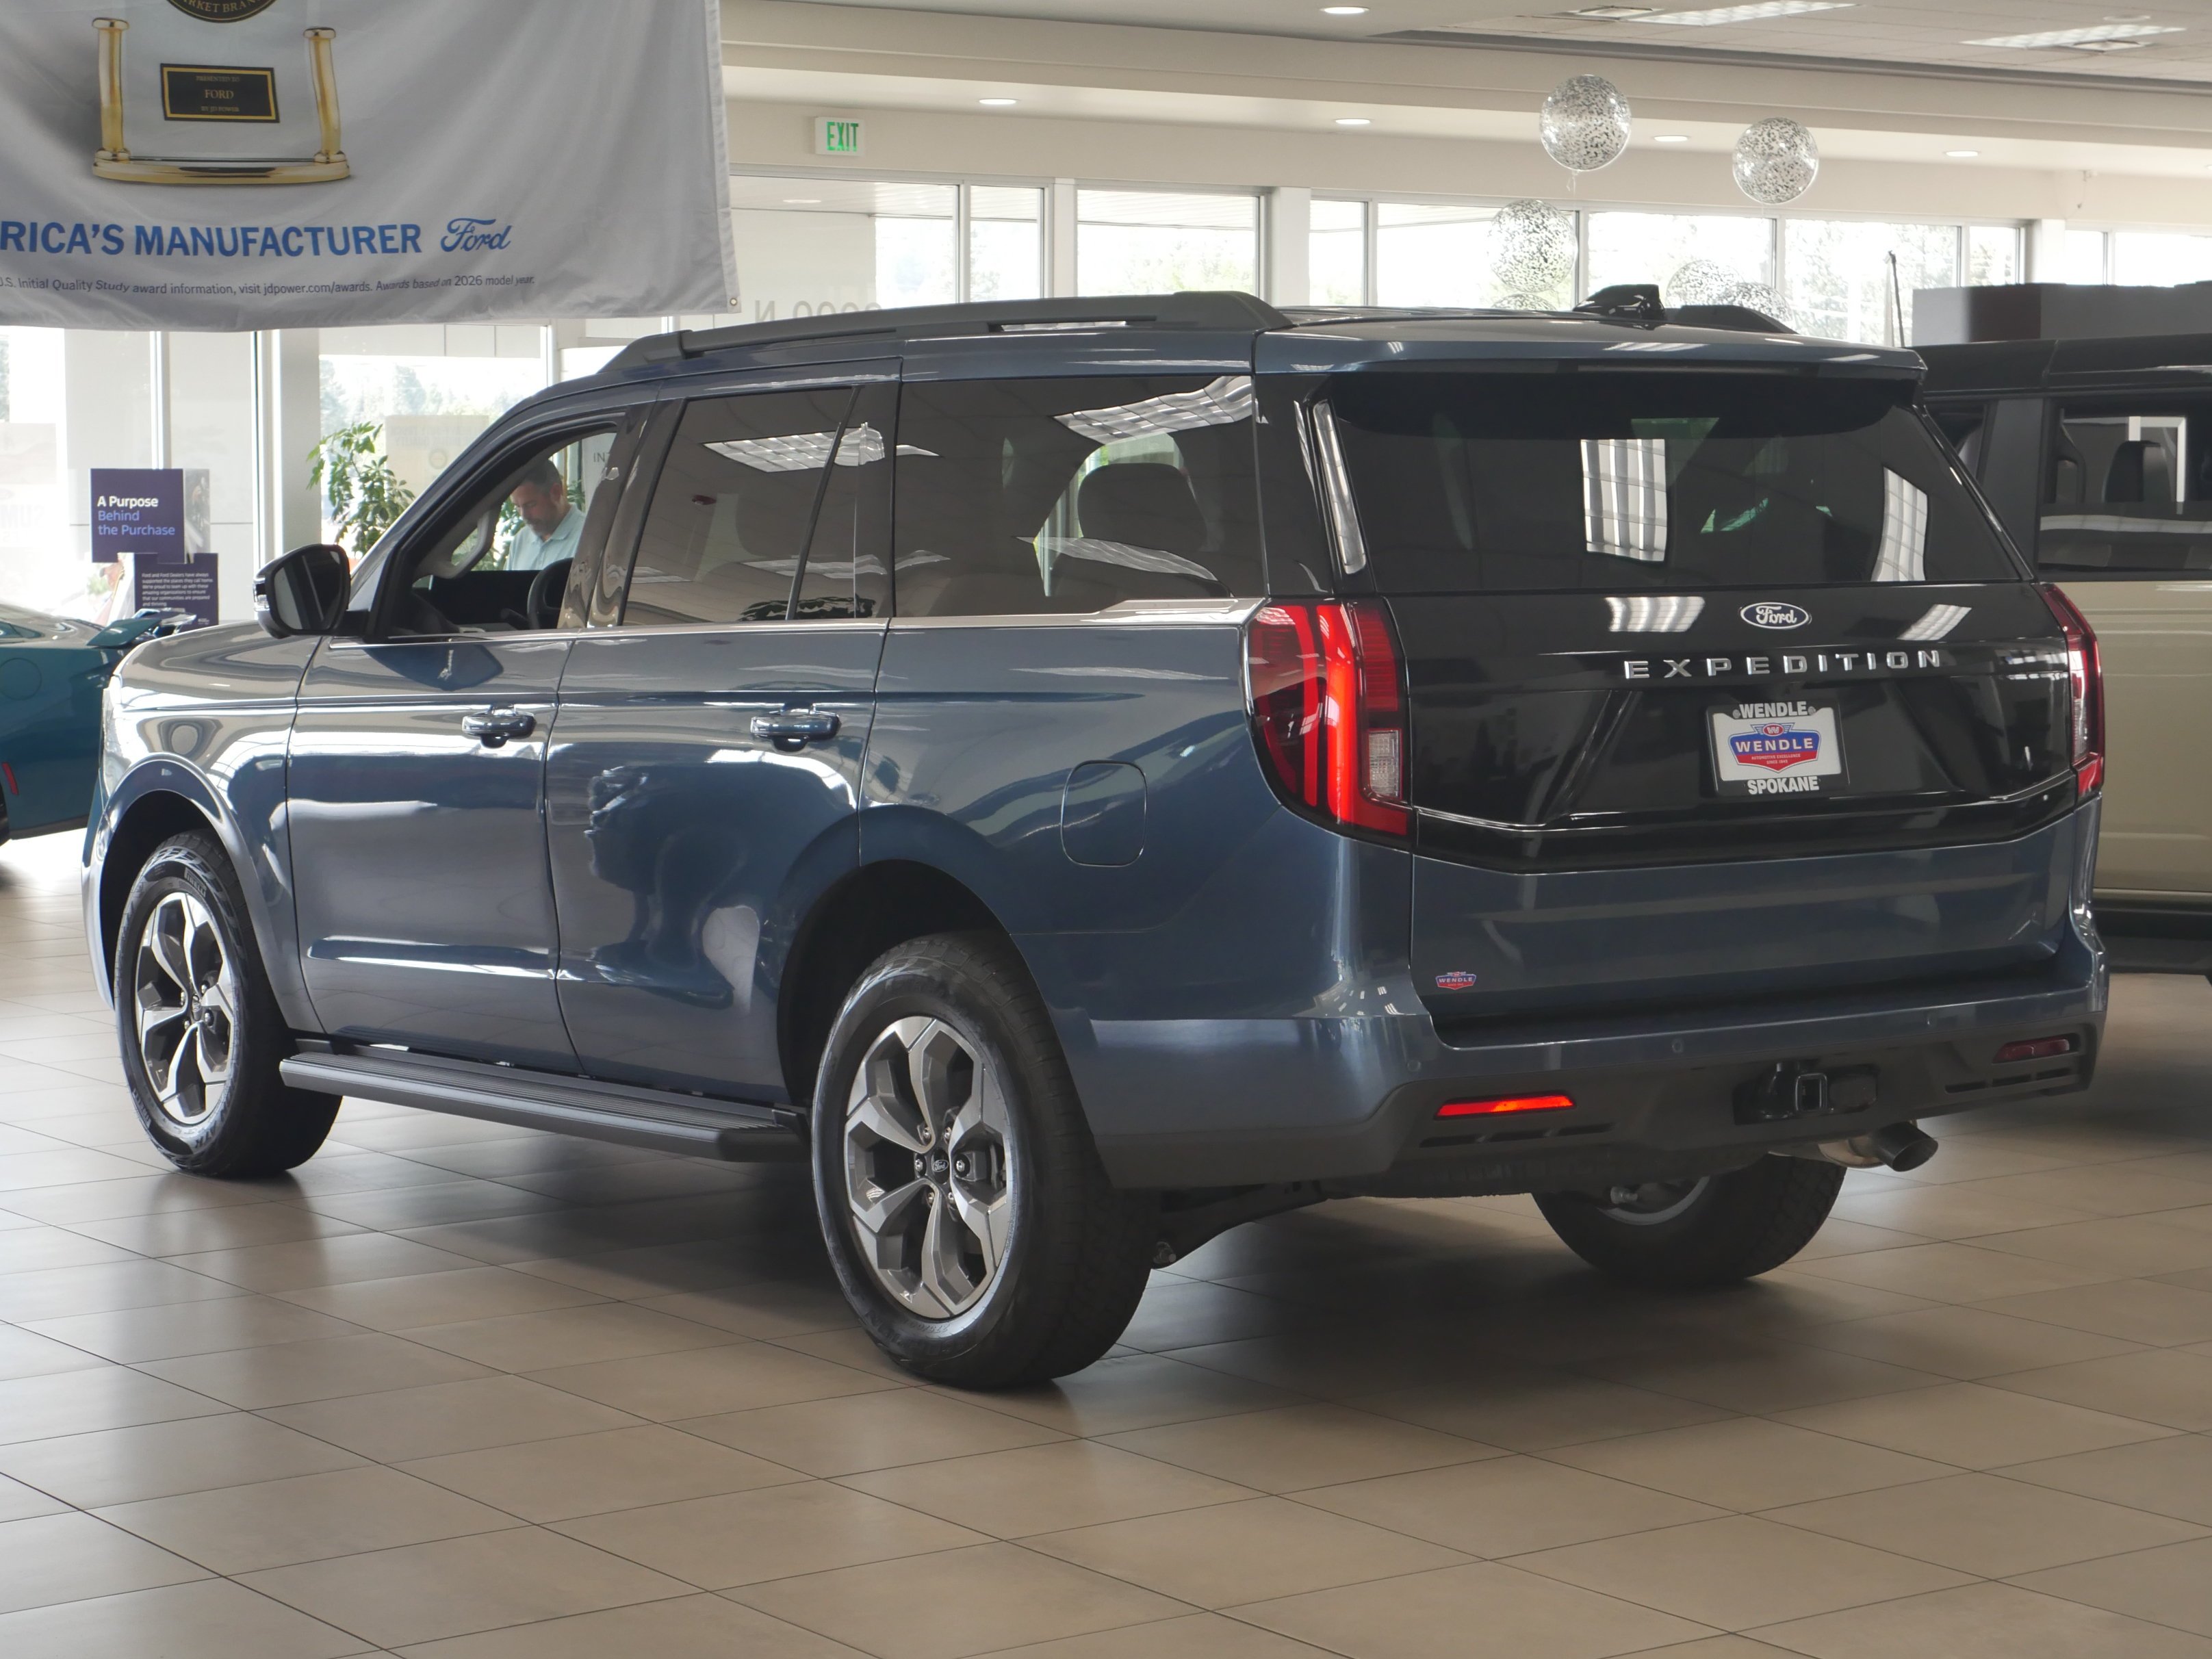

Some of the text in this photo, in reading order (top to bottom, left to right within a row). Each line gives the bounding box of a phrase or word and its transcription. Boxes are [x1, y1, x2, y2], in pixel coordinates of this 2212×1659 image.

[183, 0, 258, 12] RKET BRAN
[205, 89, 234, 99] FORD
[826, 121, 858, 152] EXIT
[0, 218, 512, 257] RICA'S MANUFACTURER Ford
[18, 278, 49, 289] Initial
[53, 279, 92, 292] Quality
[96, 280, 130, 293] Study
[133, 283, 167, 294] award
[171, 283, 236, 295] information,
[240, 283, 261, 294] visit
[263, 281, 372, 296] jdpower.com/awards.
[376, 279, 409, 291] Awards
[412, 278, 440, 289] based
[441, 279, 452, 287] on
[454, 275, 483, 286] 2026
[485, 275, 513, 285] model
[515, 276, 535, 286] year.
[97, 496, 159, 509] A Purpose
[98, 510, 140, 521] Behind
[98, 524, 175, 535] the Purchase
[1754, 604, 1799, 626] Ford
[1624, 650, 1940, 680] EXPEDITION
[1739, 701, 1808, 719] WENDLE
[1766, 726, 1779, 734] W
[1736, 738, 1814, 753] WENDLE
[1747, 776, 1819, 795] SPOKANE
